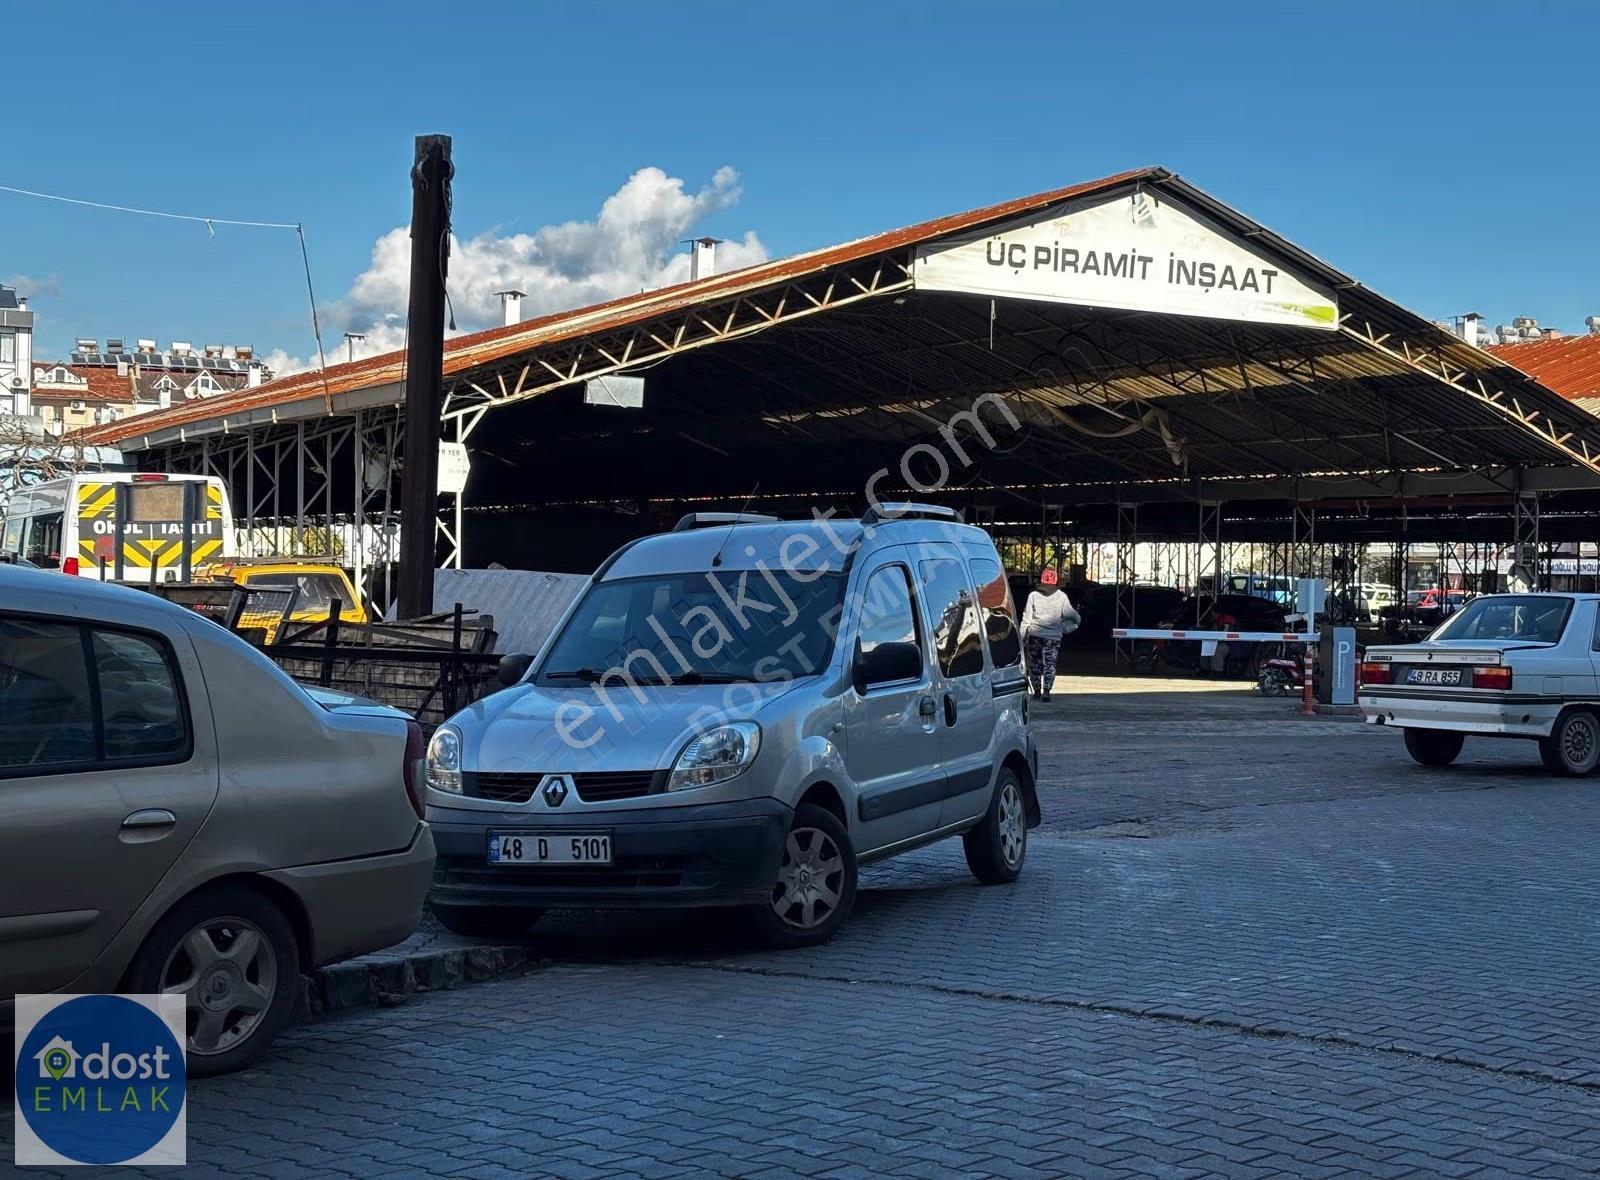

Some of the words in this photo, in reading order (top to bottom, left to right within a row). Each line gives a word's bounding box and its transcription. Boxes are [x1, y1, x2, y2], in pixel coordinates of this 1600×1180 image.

[986, 236, 1027, 275] ÜÇ
[1033, 240, 1153, 281] PİRAMİT
[1168, 251, 1278, 295] İNŞAAT
[1425, 671, 1438, 682] RA
[1441, 671, 1459, 684] 855
[502, 838, 522, 860] 48
[538, 838, 549, 860] D
[571, 838, 608, 860] 5101
